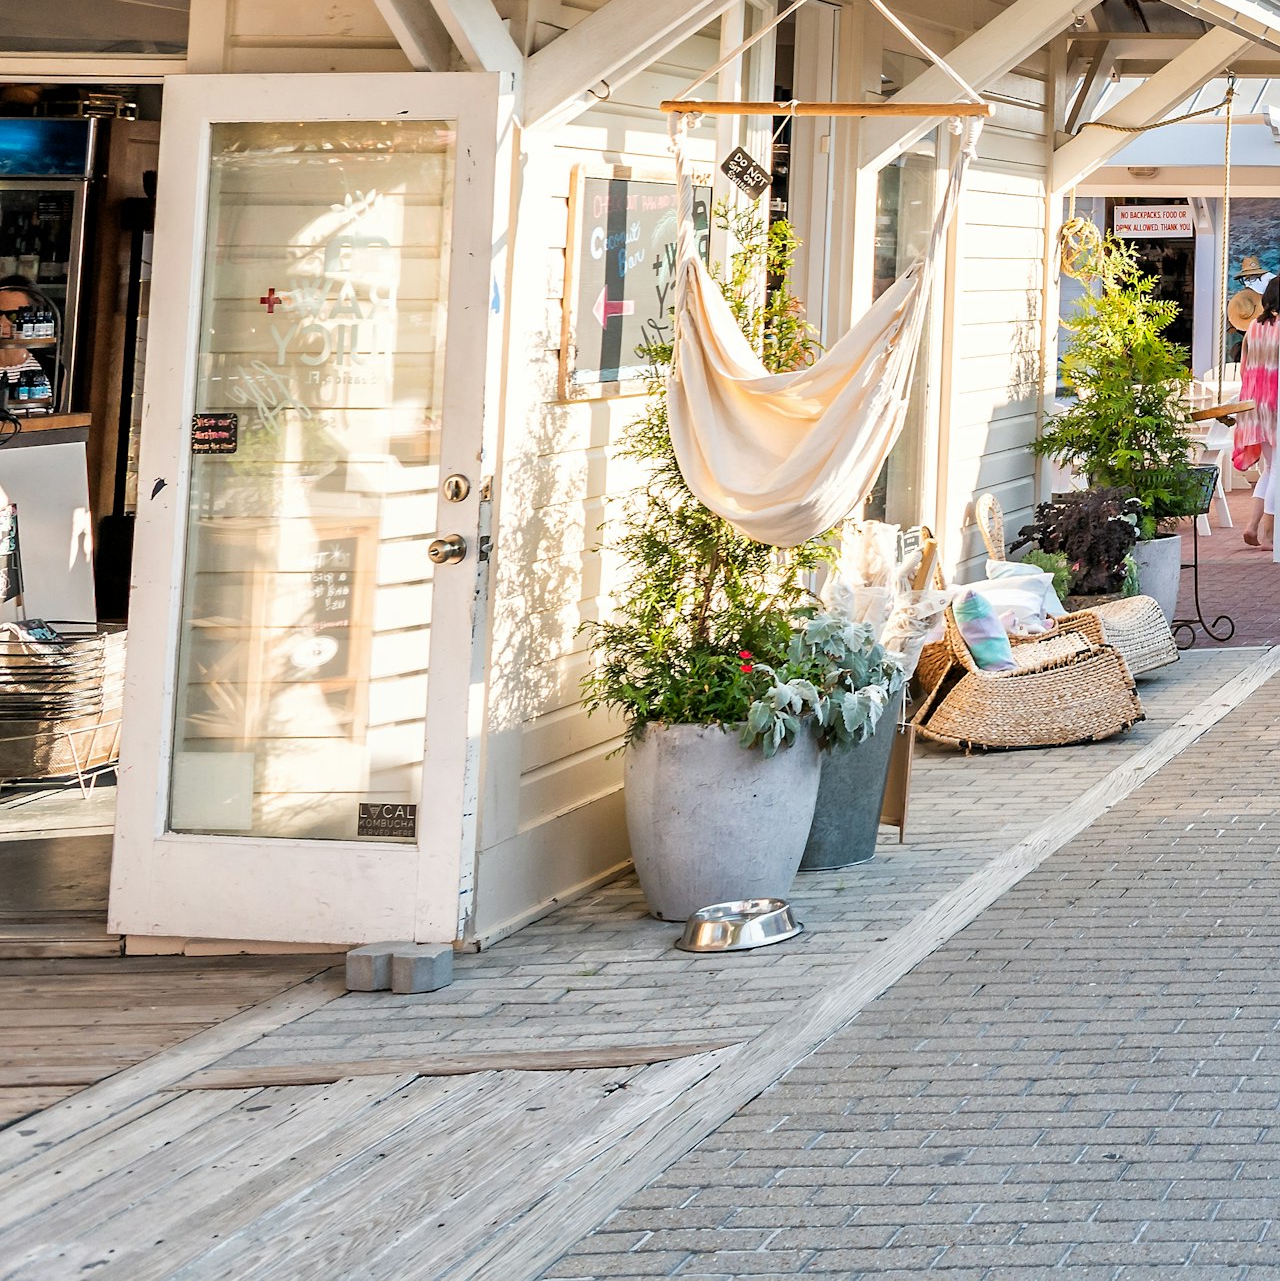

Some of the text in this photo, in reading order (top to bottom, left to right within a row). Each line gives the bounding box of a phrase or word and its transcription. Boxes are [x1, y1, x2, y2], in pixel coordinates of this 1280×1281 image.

[729, 161, 756, 186] SIT ON
[734, 152, 768, 186] DO NOT
[618, 248, 645, 278] Bar
[359, 819, 414, 828] KOMBUCHA
[359, 828, 390, 836] SERVED
